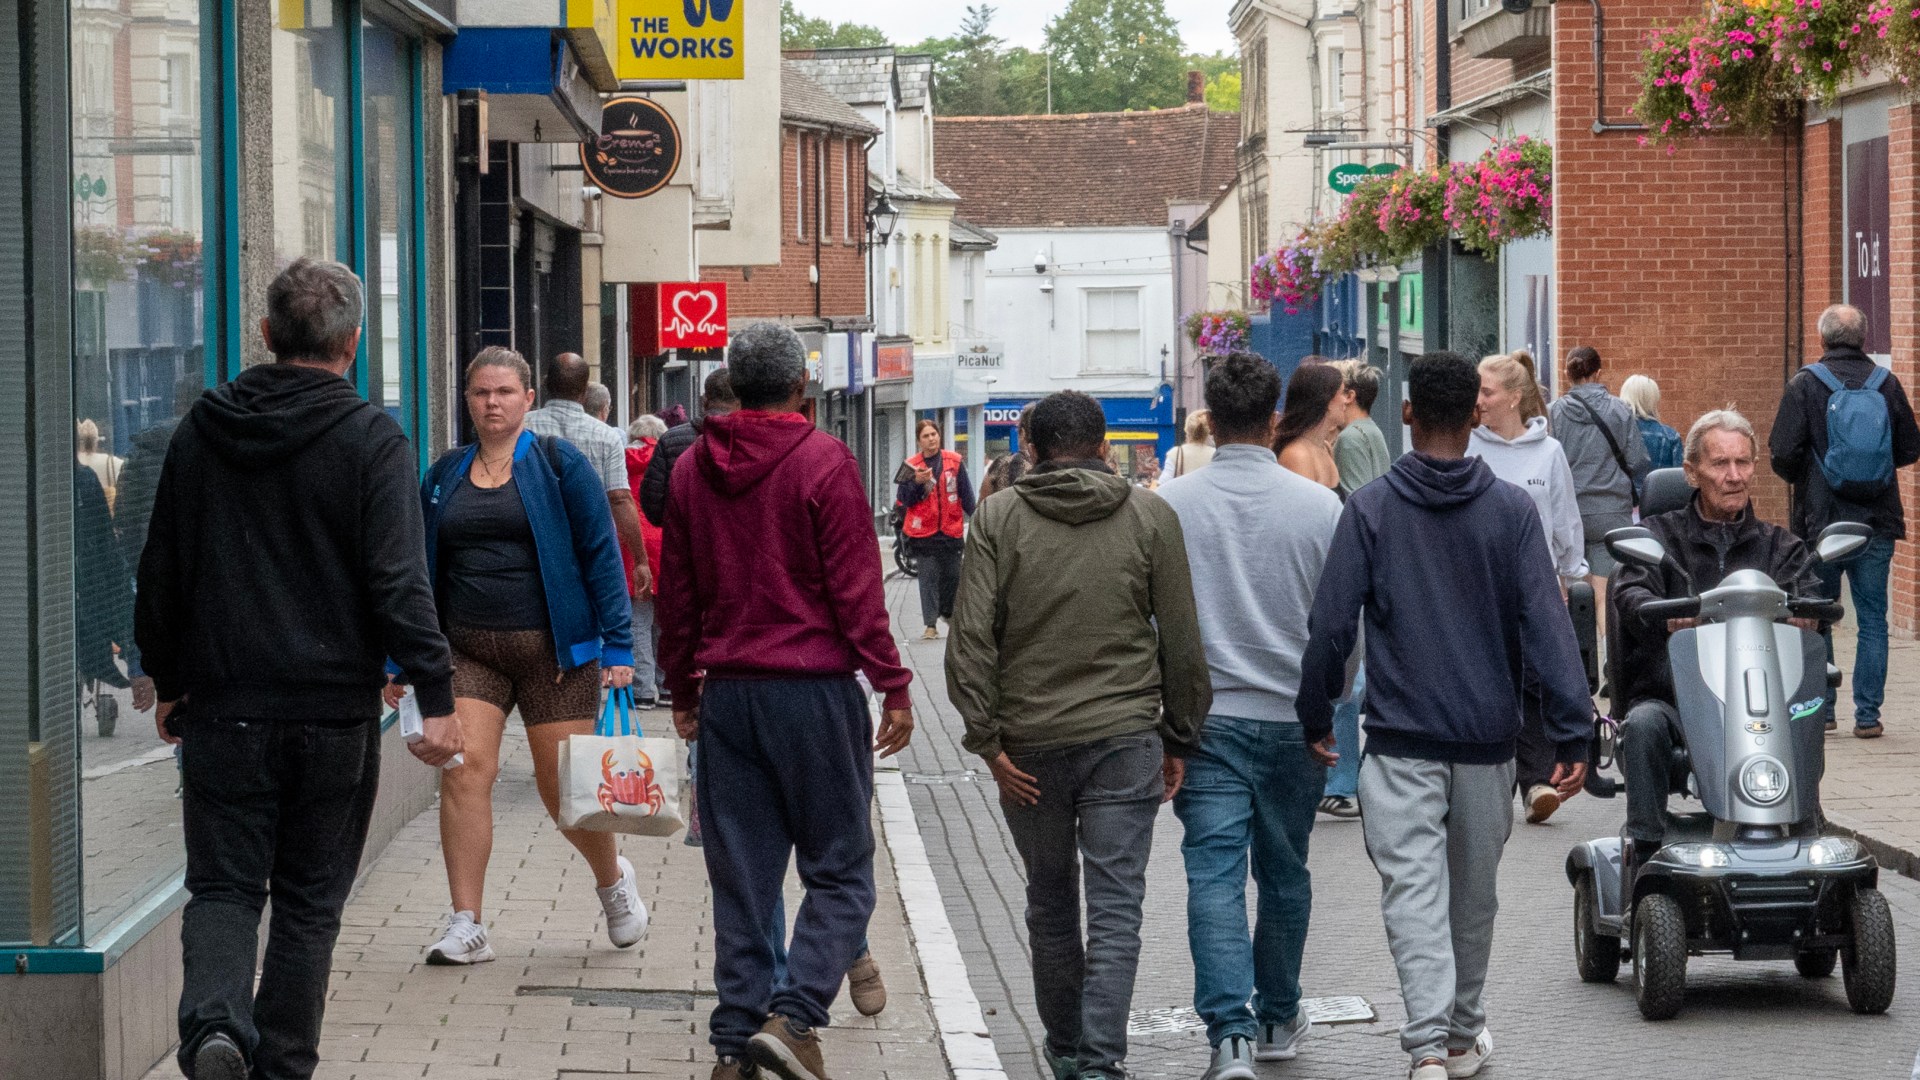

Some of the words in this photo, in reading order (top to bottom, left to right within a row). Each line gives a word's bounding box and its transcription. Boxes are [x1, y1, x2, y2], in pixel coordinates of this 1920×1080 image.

[630, 17, 669, 33] THE
[630, 37, 734, 59] WORKS
[1855, 231, 1869, 278] To
[958, 354, 1001, 367] PicaNut
